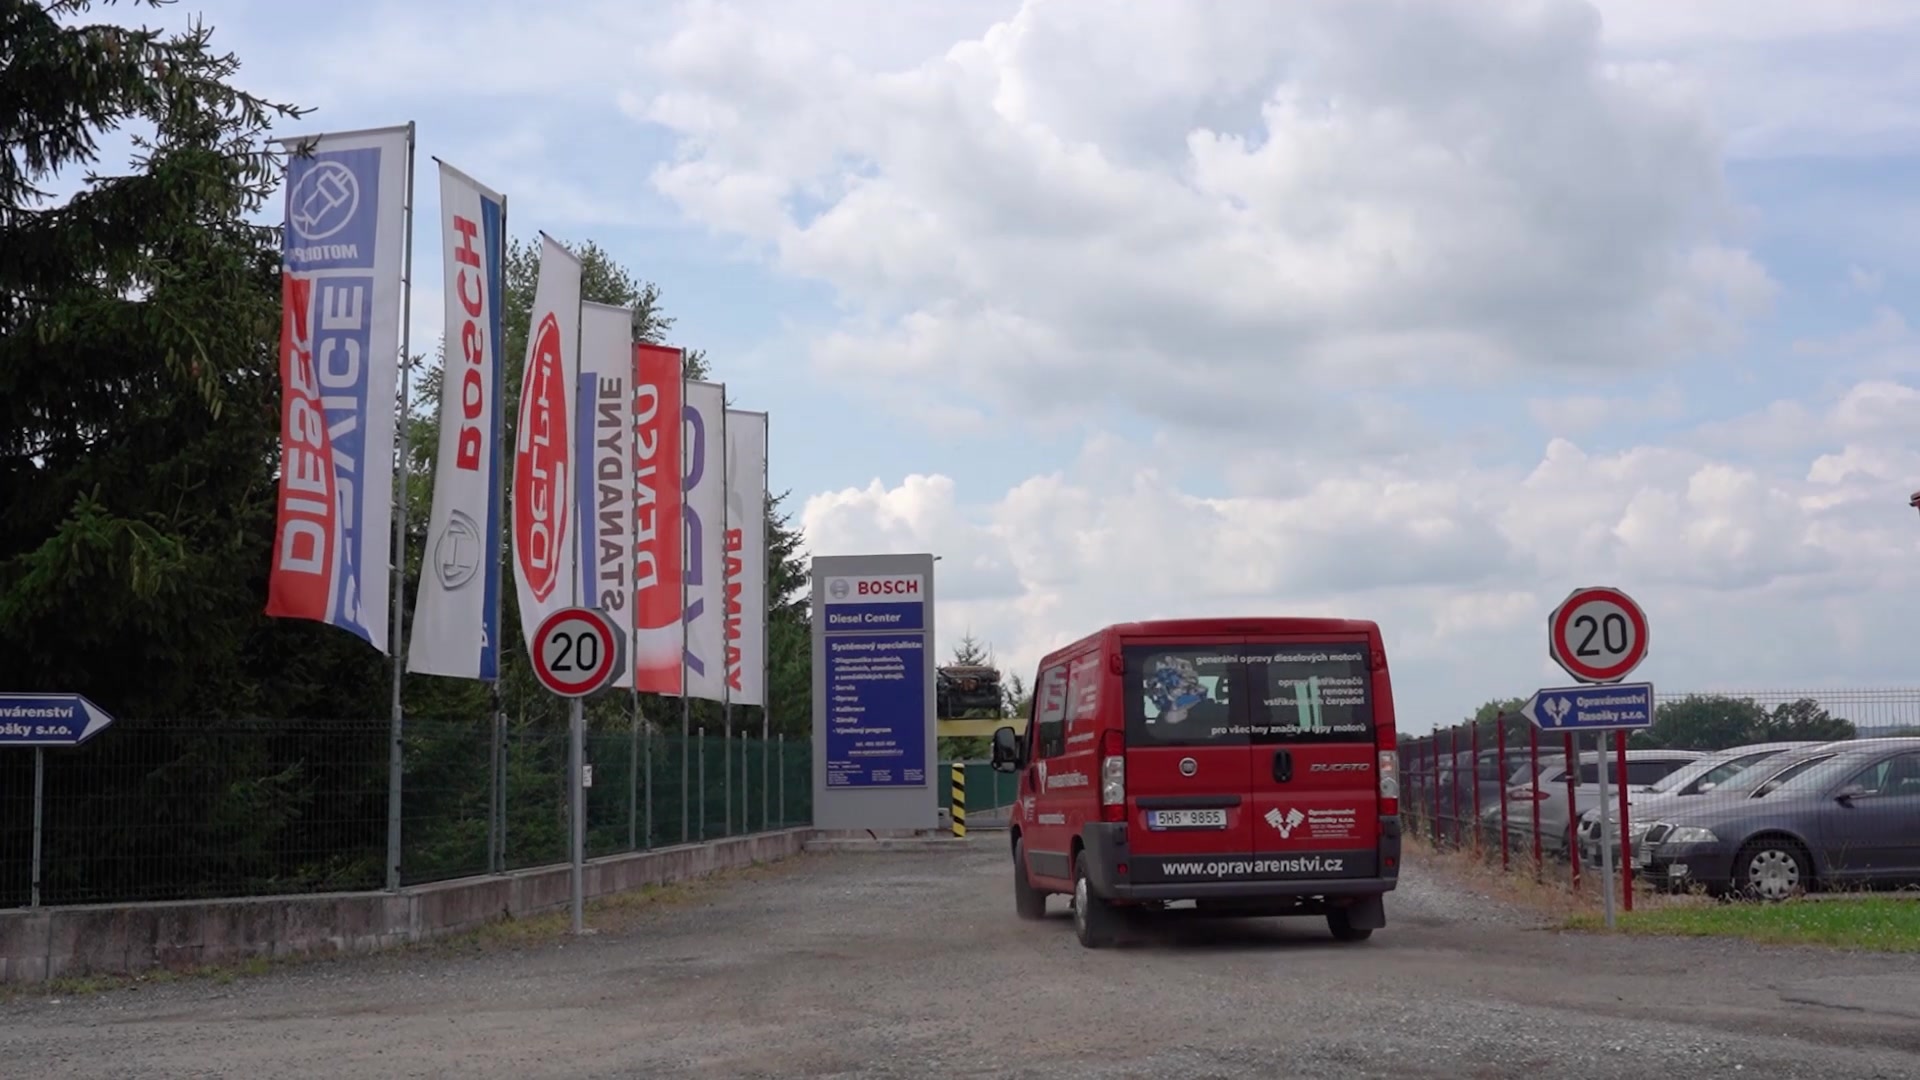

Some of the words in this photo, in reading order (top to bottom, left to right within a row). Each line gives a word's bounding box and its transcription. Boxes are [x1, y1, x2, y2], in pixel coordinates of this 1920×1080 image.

[858, 580, 918, 595] BOSCH
[829, 614, 862, 623] Diesel
[864, 613, 901, 622] Center
[1574, 613, 1627, 656] 20
[551, 632, 598, 671] 20
[1621, 711, 1646, 719] s.r.o.
[35, 726, 72, 735] s.r.o.
[1211, 727, 1227, 735] pro
[1310, 763, 1370, 771] DUCATO
[1159, 812, 1181, 824] 5H5
[1190, 811, 1220, 824] 9855
[1162, 856, 1343, 877] www.opravarenstvi.cz
